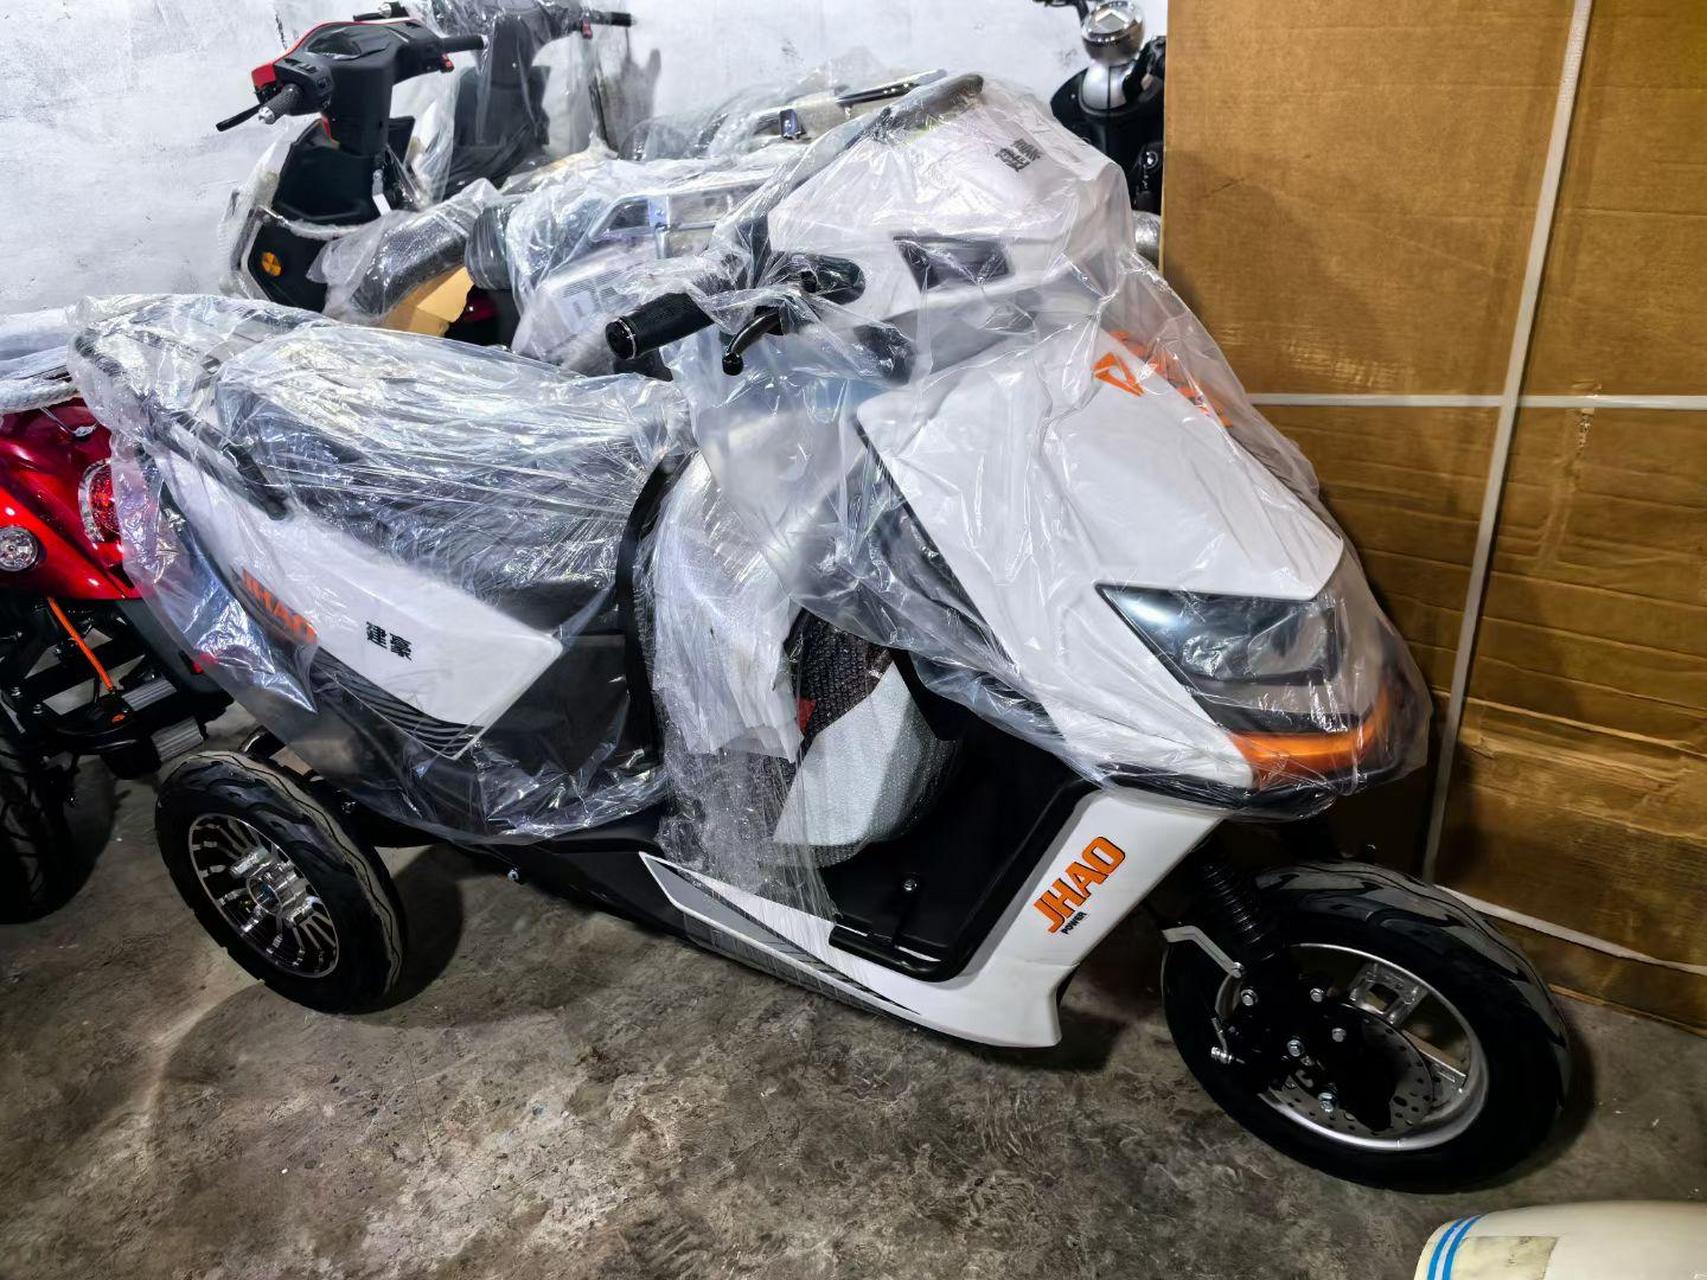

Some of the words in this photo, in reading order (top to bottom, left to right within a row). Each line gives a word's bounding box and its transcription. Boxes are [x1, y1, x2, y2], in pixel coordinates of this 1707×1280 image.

[366, 621, 412, 661] 建豪
[1033, 836, 1125, 933] JHAO
[1061, 911, 1088, 934] POWER
